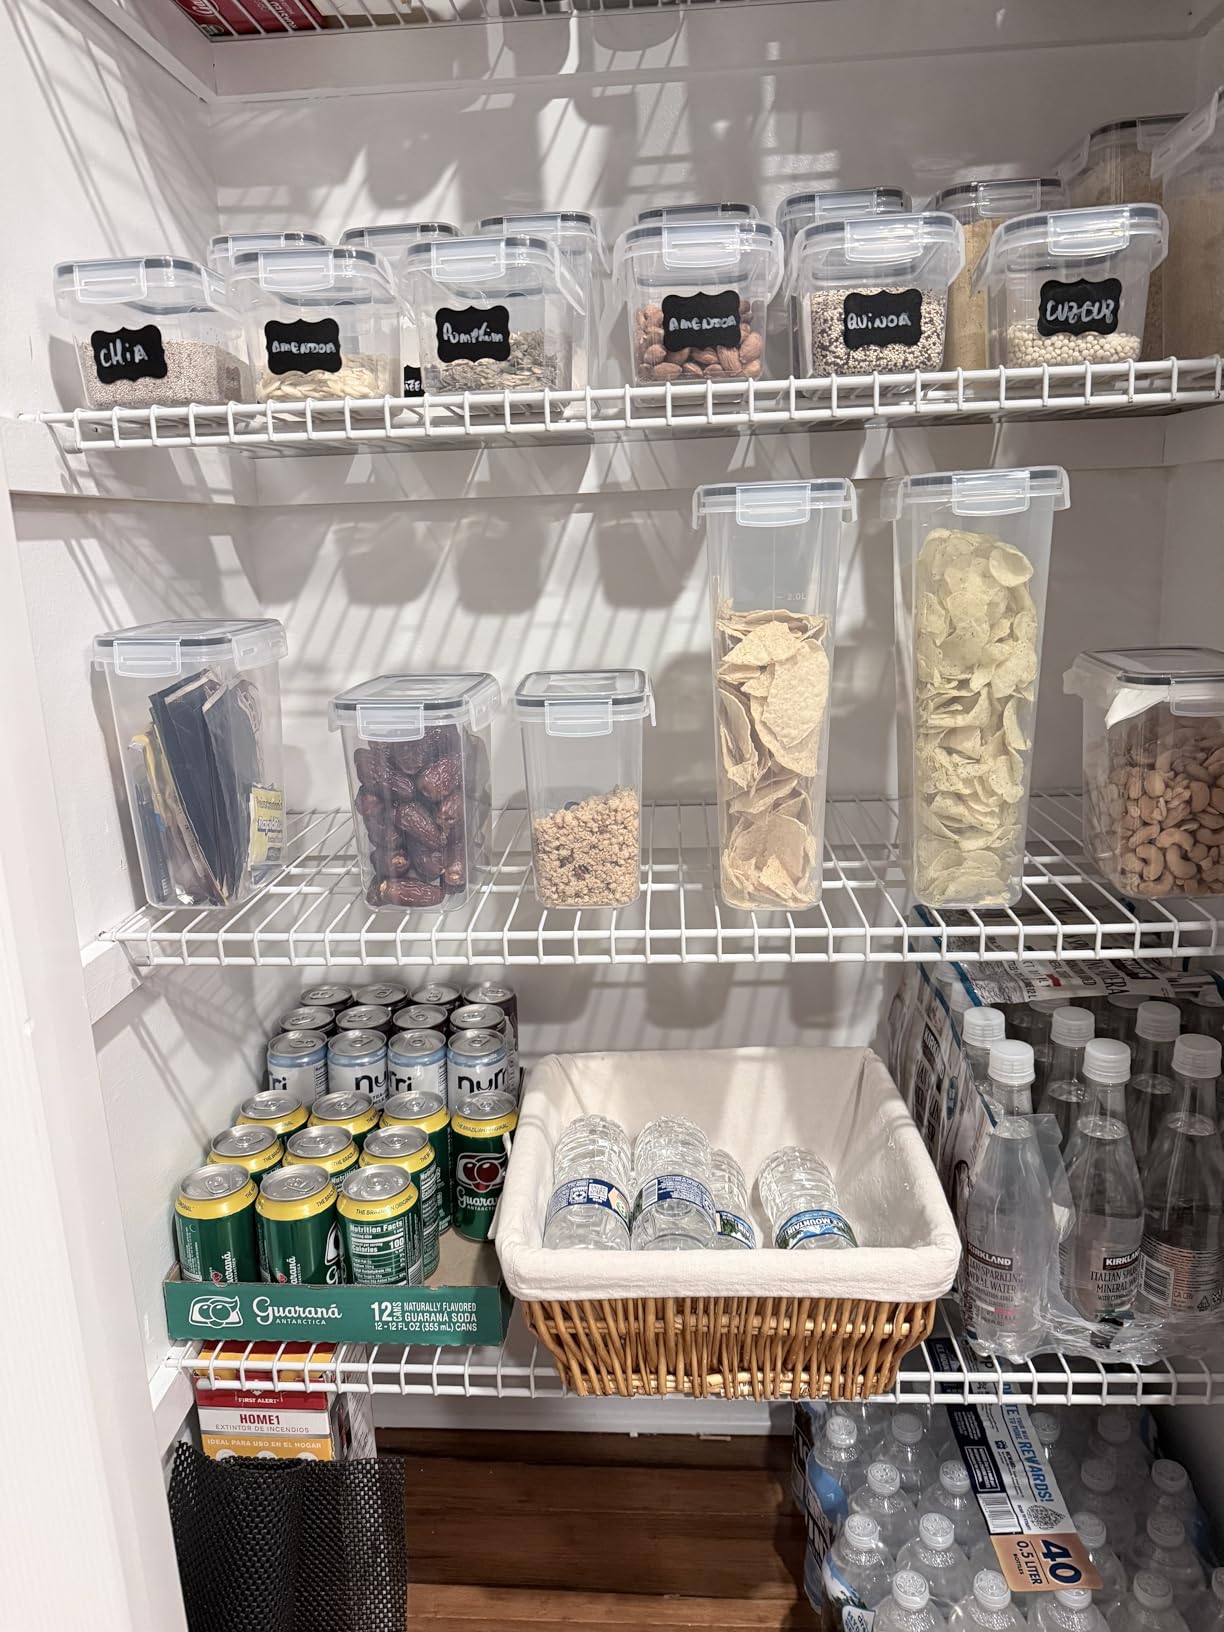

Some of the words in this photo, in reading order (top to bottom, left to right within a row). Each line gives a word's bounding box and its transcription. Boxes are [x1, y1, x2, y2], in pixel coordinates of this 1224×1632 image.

[457, 1187, 497, 1208] Guara
[383, 1220, 403, 1231] Facts
[389, 1237, 404, 1249] 100
[968, 1243, 1012, 1266] KIRKLAND
[1106, 1248, 1141, 1266] KIRKLAN
[1090, 1271, 1121, 1282] ITALIAN
[1097, 1281, 1128, 1293] MINERAL
[253, 1296, 342, 1325] Guaraná
[371, 1301, 392, 1322] 12
[393, 1302, 402, 1321] CANS
[404, 1302, 441, 1311] NATURALLY
[443, 1302, 476, 1311] FLAVORED
[405, 1312, 448, 1322] GUARANÁ
[452, 1313, 476, 1322] SODA
[399, 1323, 408, 1331] FL
[409, 1323, 420, 1331] OZ
[422, 1323, 438, 1332] (355
[440, 1324, 453, 1332] mL)
[240, 1414, 280, 1425] HOME1
[1018, 1441, 1054, 1503] REWARDS!
[1017, 1540, 1034, 1559] 0.5
[1040, 1539, 1083, 1585] 40
[1025, 1560, 1042, 1585] LITER
